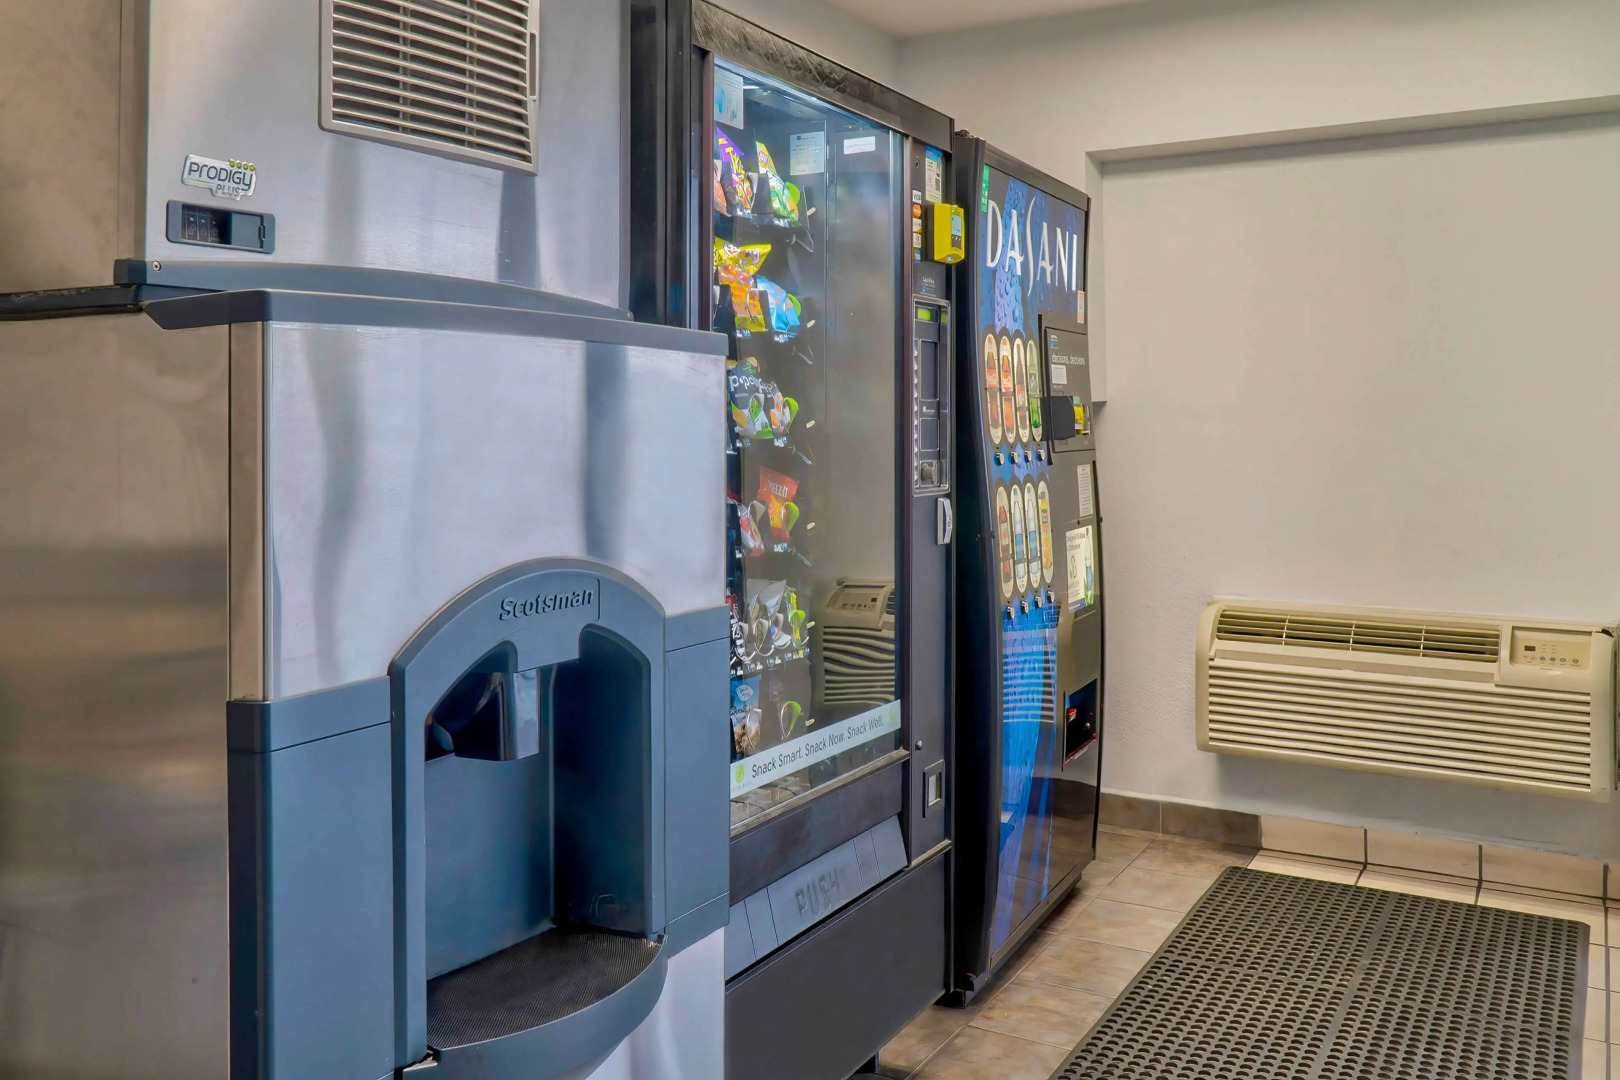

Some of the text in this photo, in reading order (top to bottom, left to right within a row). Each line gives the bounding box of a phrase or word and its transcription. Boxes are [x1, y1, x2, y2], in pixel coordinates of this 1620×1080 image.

[215, 183, 241, 197] PLUS
[986, 196, 1078, 297] DASANI
[499, 589, 594, 621] Scotsman
[751, 757, 777, 779] Snack
[778, 748, 804, 768] Smart.
[805, 737, 827, 757] Snack
[828, 733, 846, 748] Now.
[847, 722, 867, 740] Snack
[795, 867, 840, 917] PUSH
